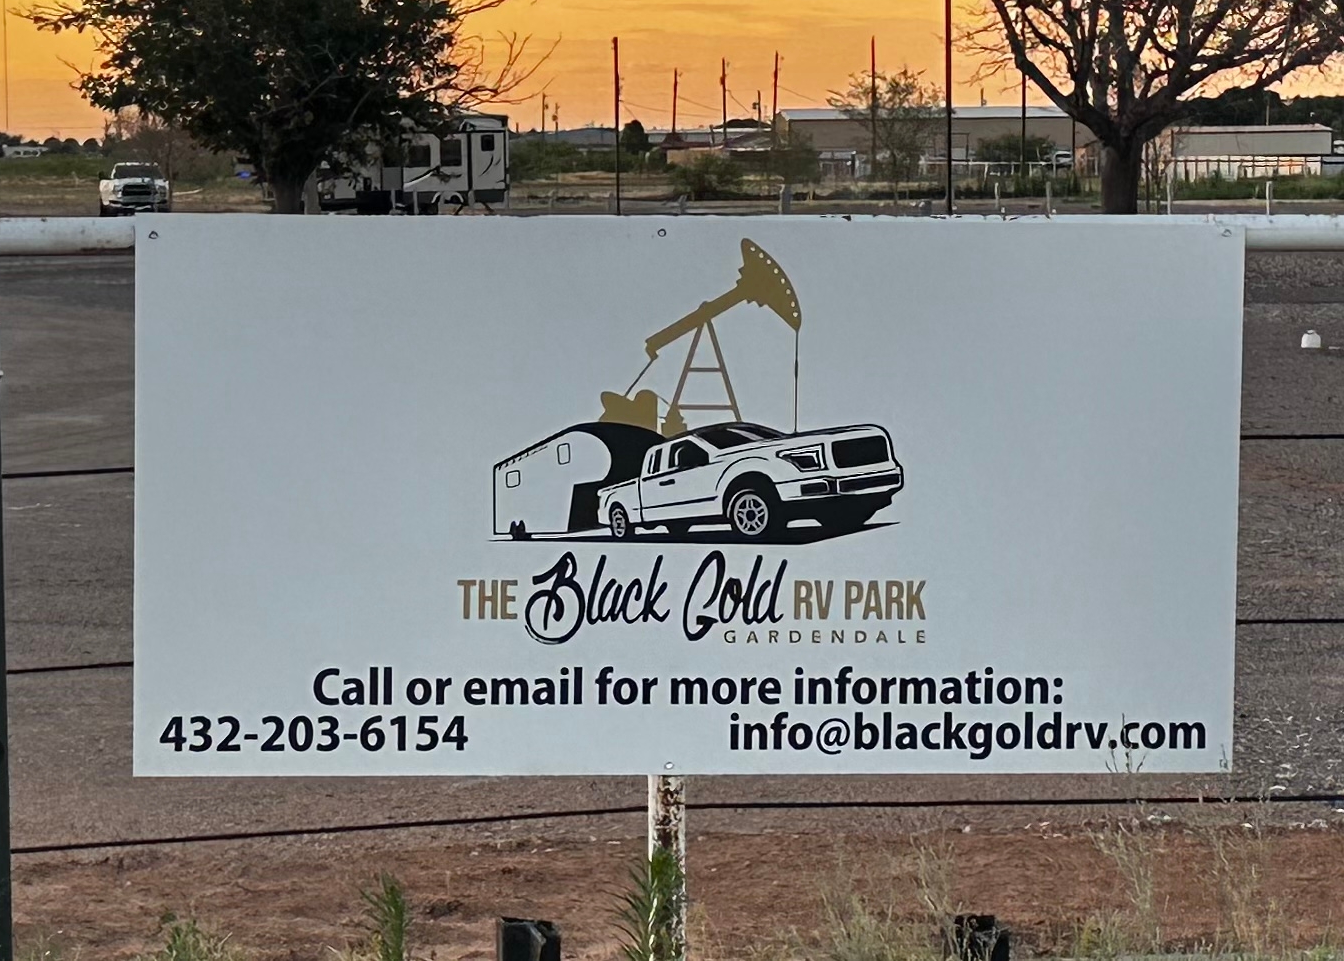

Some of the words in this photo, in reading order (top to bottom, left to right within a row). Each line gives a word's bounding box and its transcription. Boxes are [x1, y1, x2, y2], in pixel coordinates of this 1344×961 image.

[457, 579, 519, 620] THE
[524, 550, 671, 646] Black
[682, 549, 788, 642] Gold
[793, 580, 833, 620] RV
[844, 580, 927, 620] PARK
[723, 629, 927, 644] GARDENDALE
[313, 666, 393, 706] Call
[405, 677, 453, 706] or
[463, 666, 583, 706] email
[594, 665, 659, 706] for
[670, 676, 782, 706] more
[794, 665, 1065, 706] information:
[159, 714, 469, 753] 432-203-6154
[730, 711, 1207, 760] info@blackgoldrv.com
